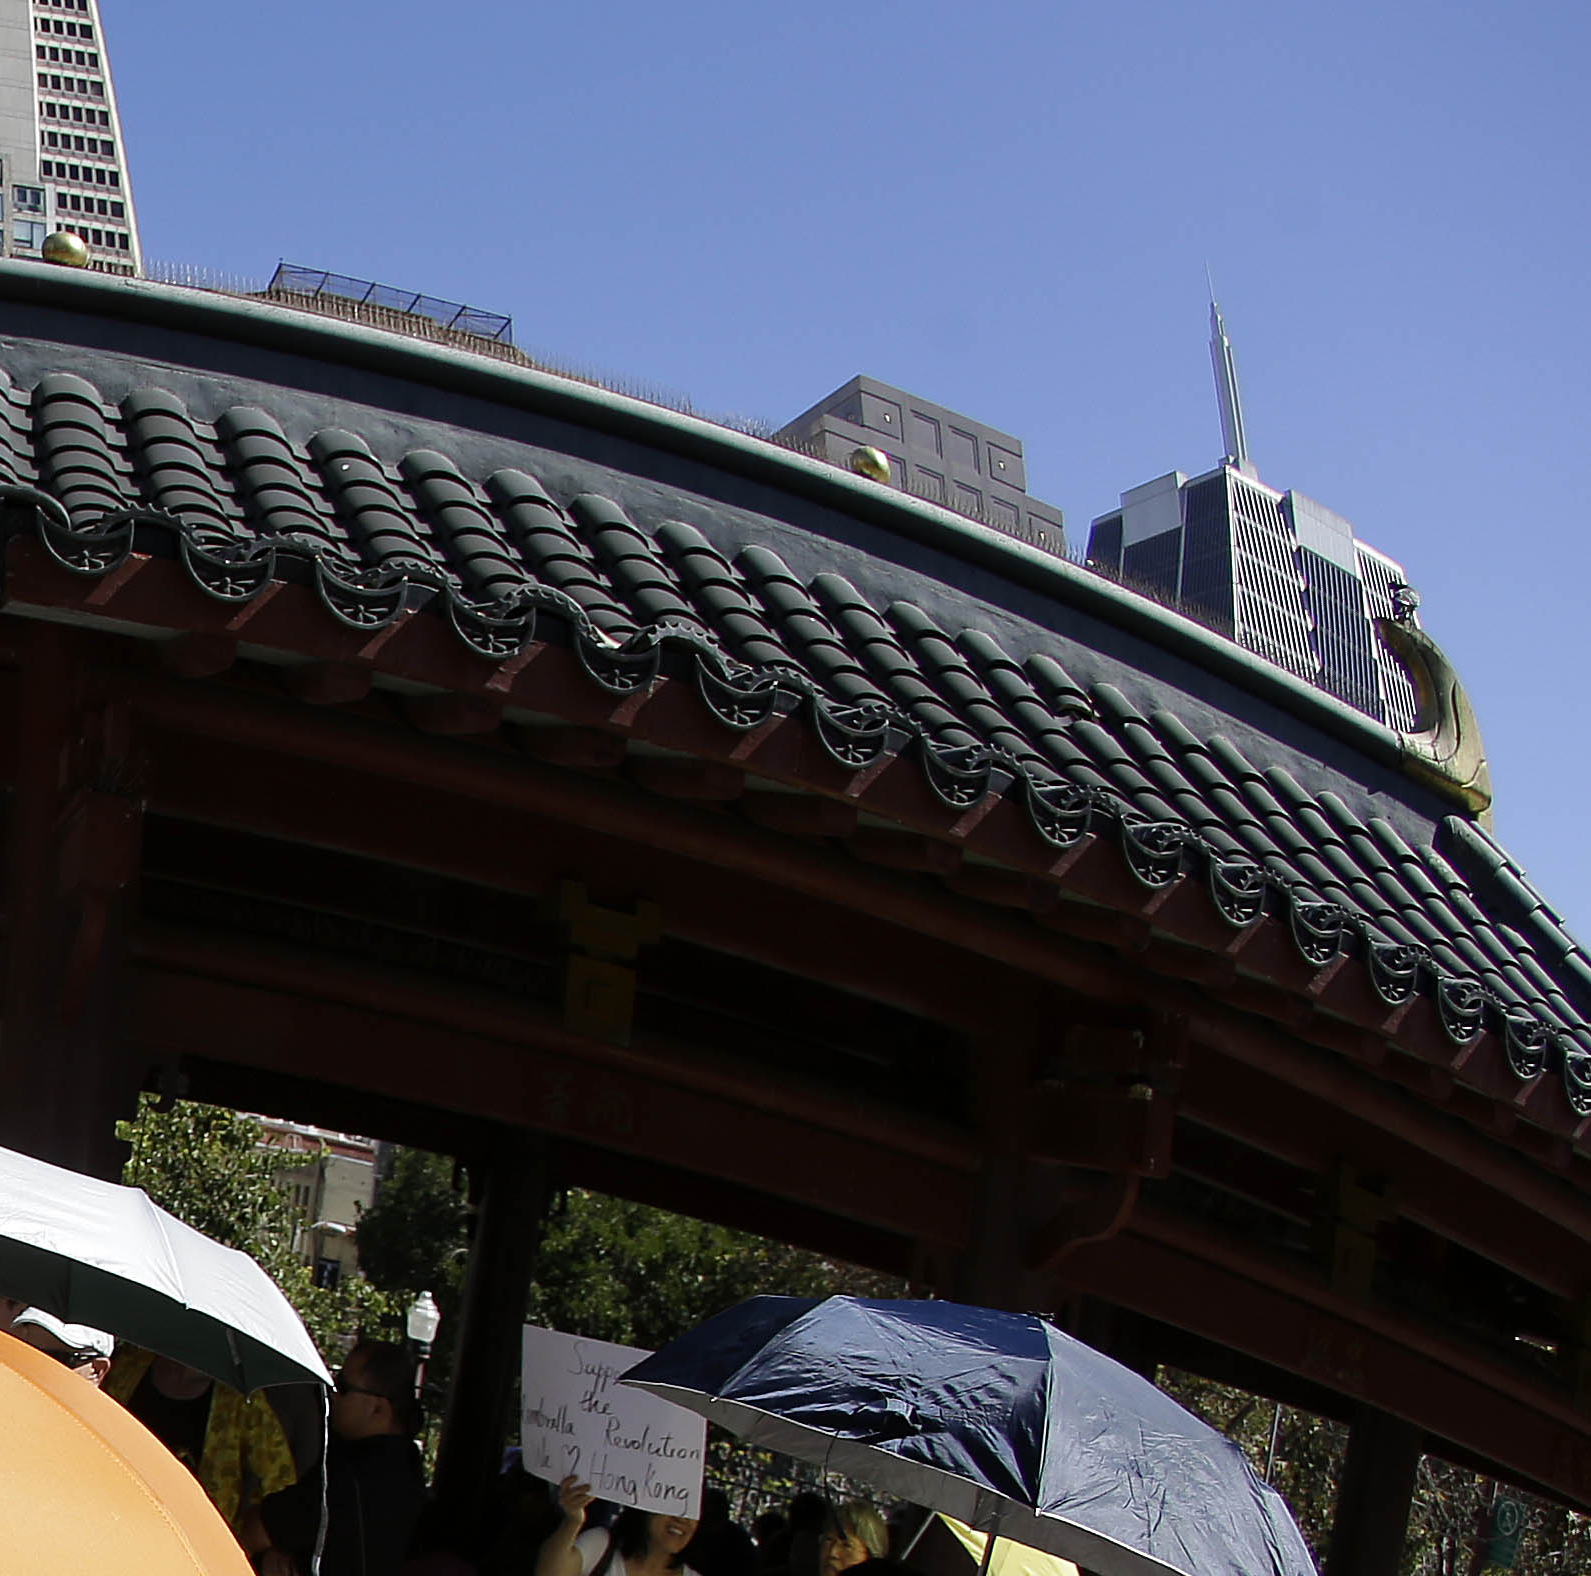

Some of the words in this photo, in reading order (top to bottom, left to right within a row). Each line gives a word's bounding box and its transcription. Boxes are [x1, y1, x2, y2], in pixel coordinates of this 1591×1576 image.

[579, 1389, 613, 1417] the
[605, 1416, 700, 1460] Revolution
[589, 1451, 637, 1506] Hong
[643, 1462, 690, 1516] Kong
